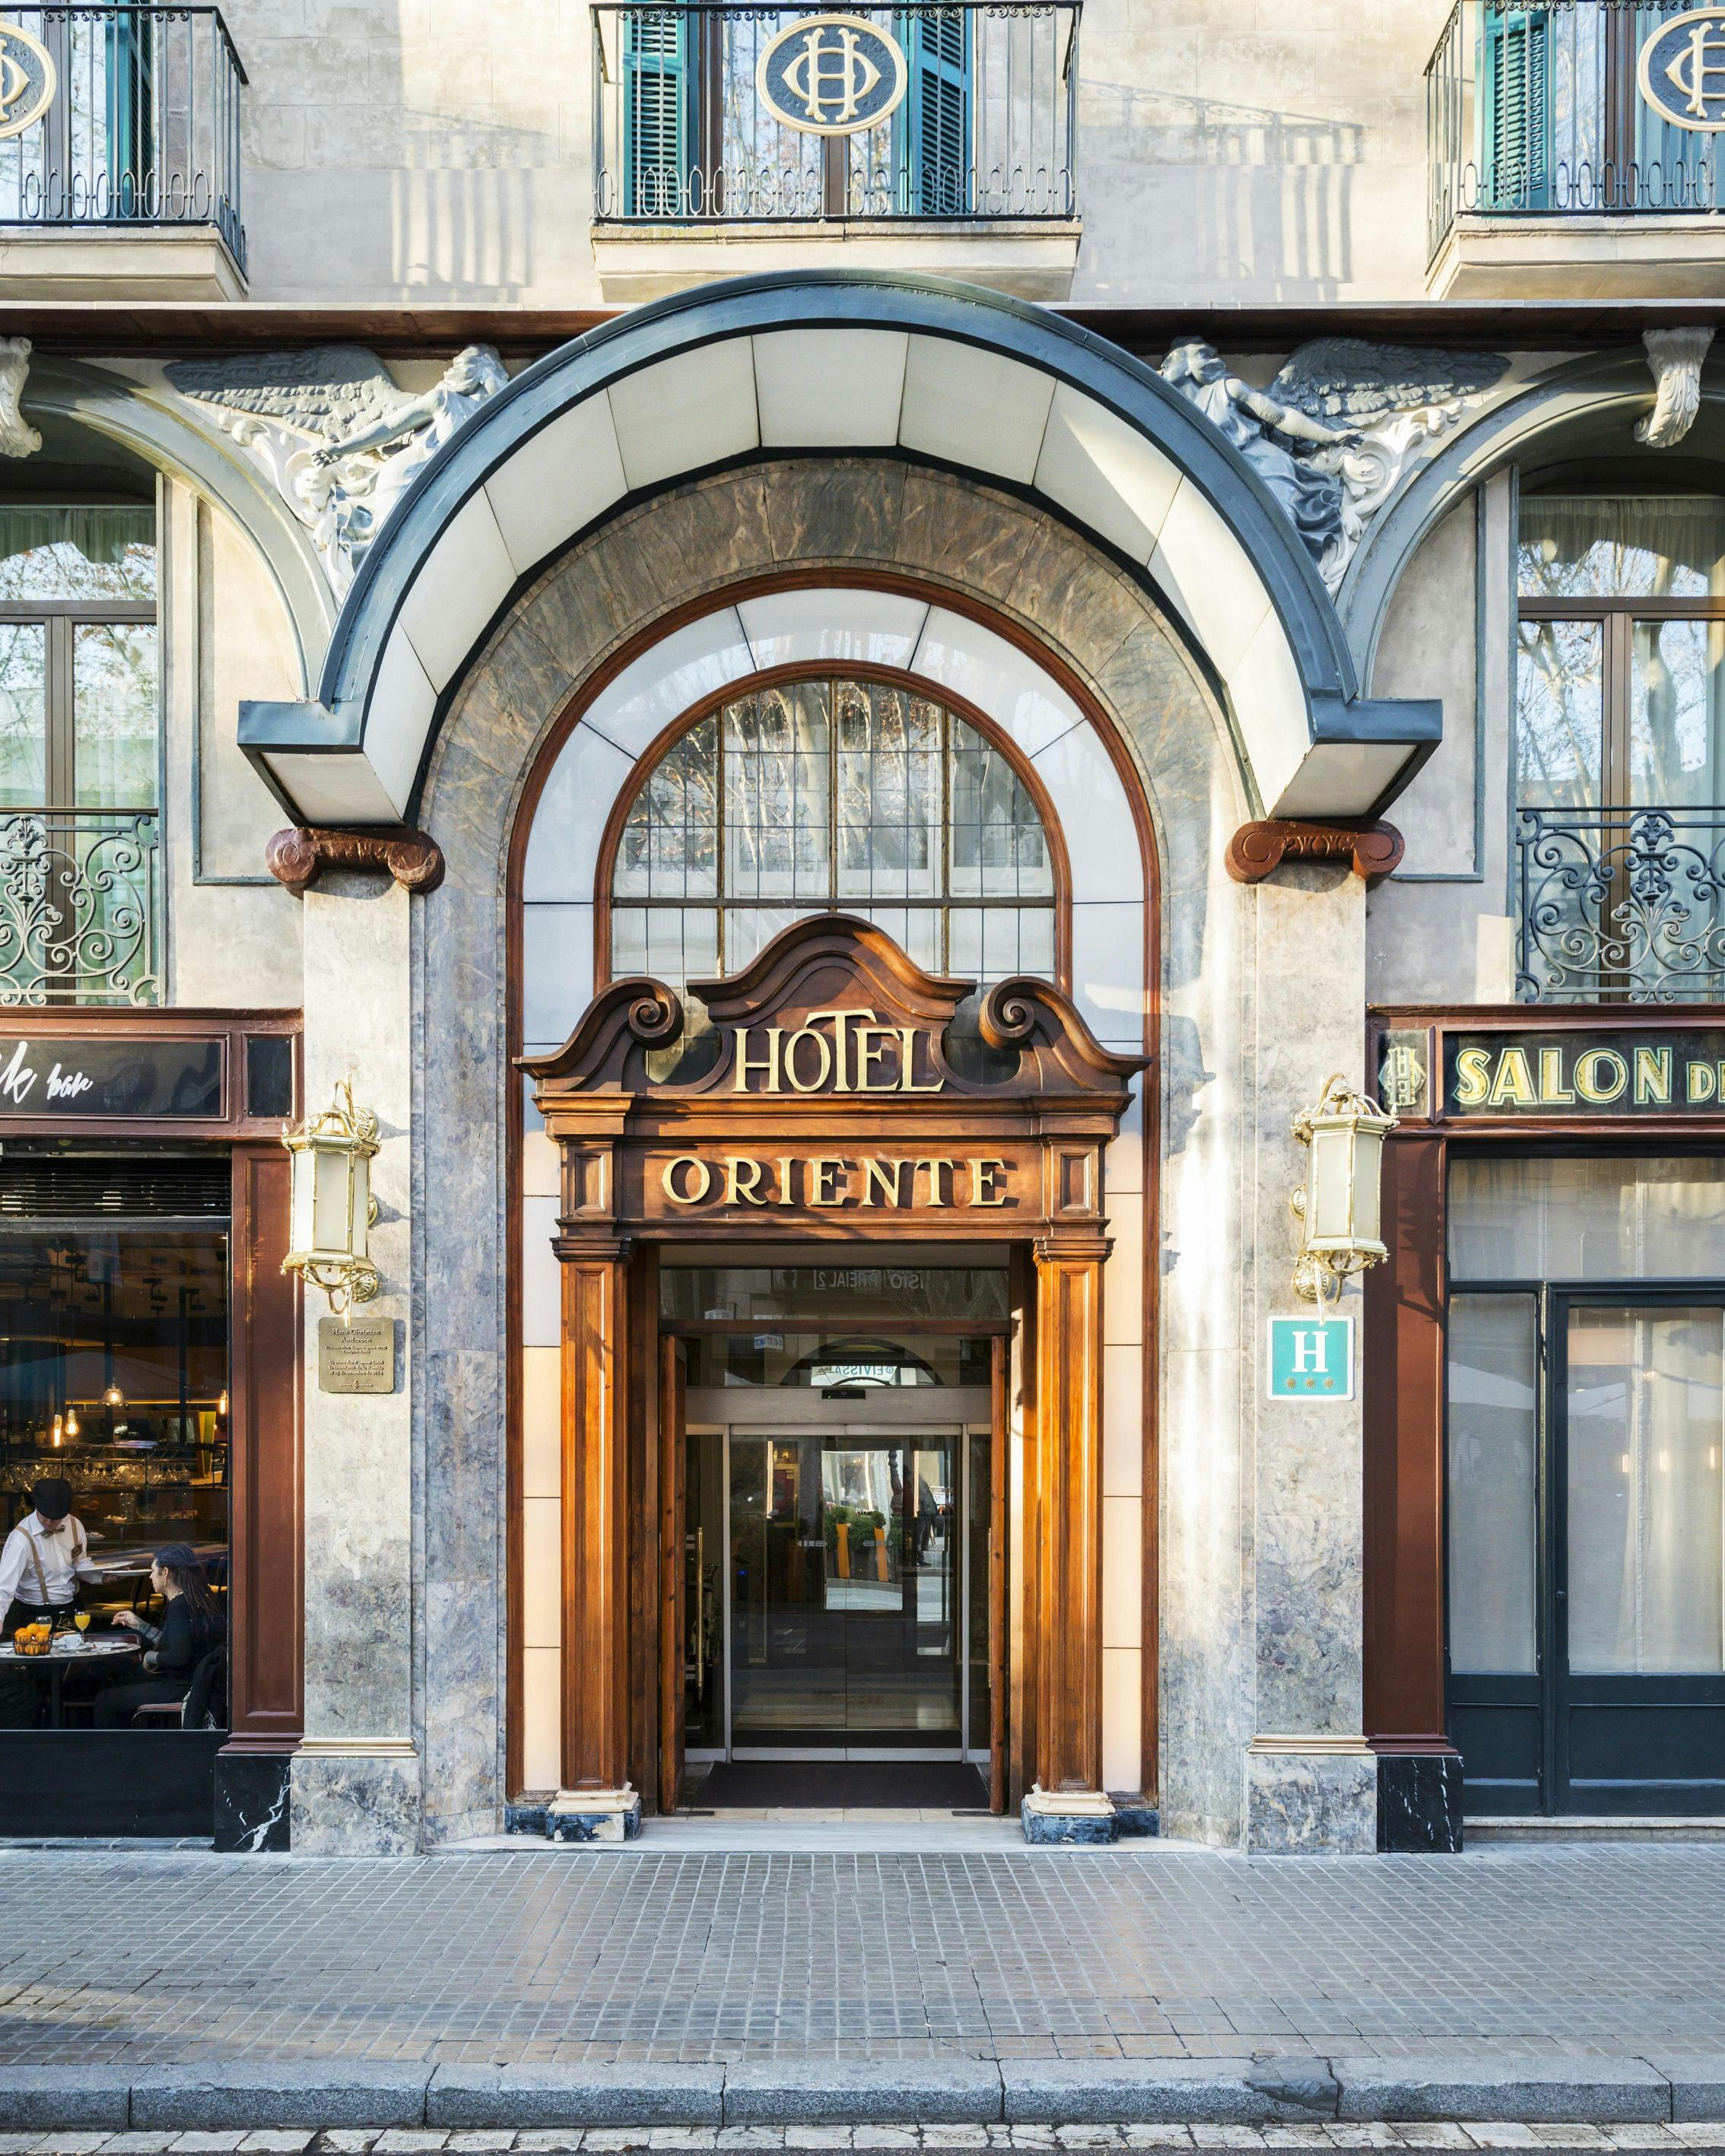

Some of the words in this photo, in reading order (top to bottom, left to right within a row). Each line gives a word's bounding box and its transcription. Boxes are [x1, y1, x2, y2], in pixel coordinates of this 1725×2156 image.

[732, 1009, 945, 1093] HOTEL
[1452, 1047, 1673, 1105] SALON
[46, 1063, 94, 1100] bar
[661, 1156, 1007, 1207] ORIENTE
[1291, 1331, 1329, 1373] H
